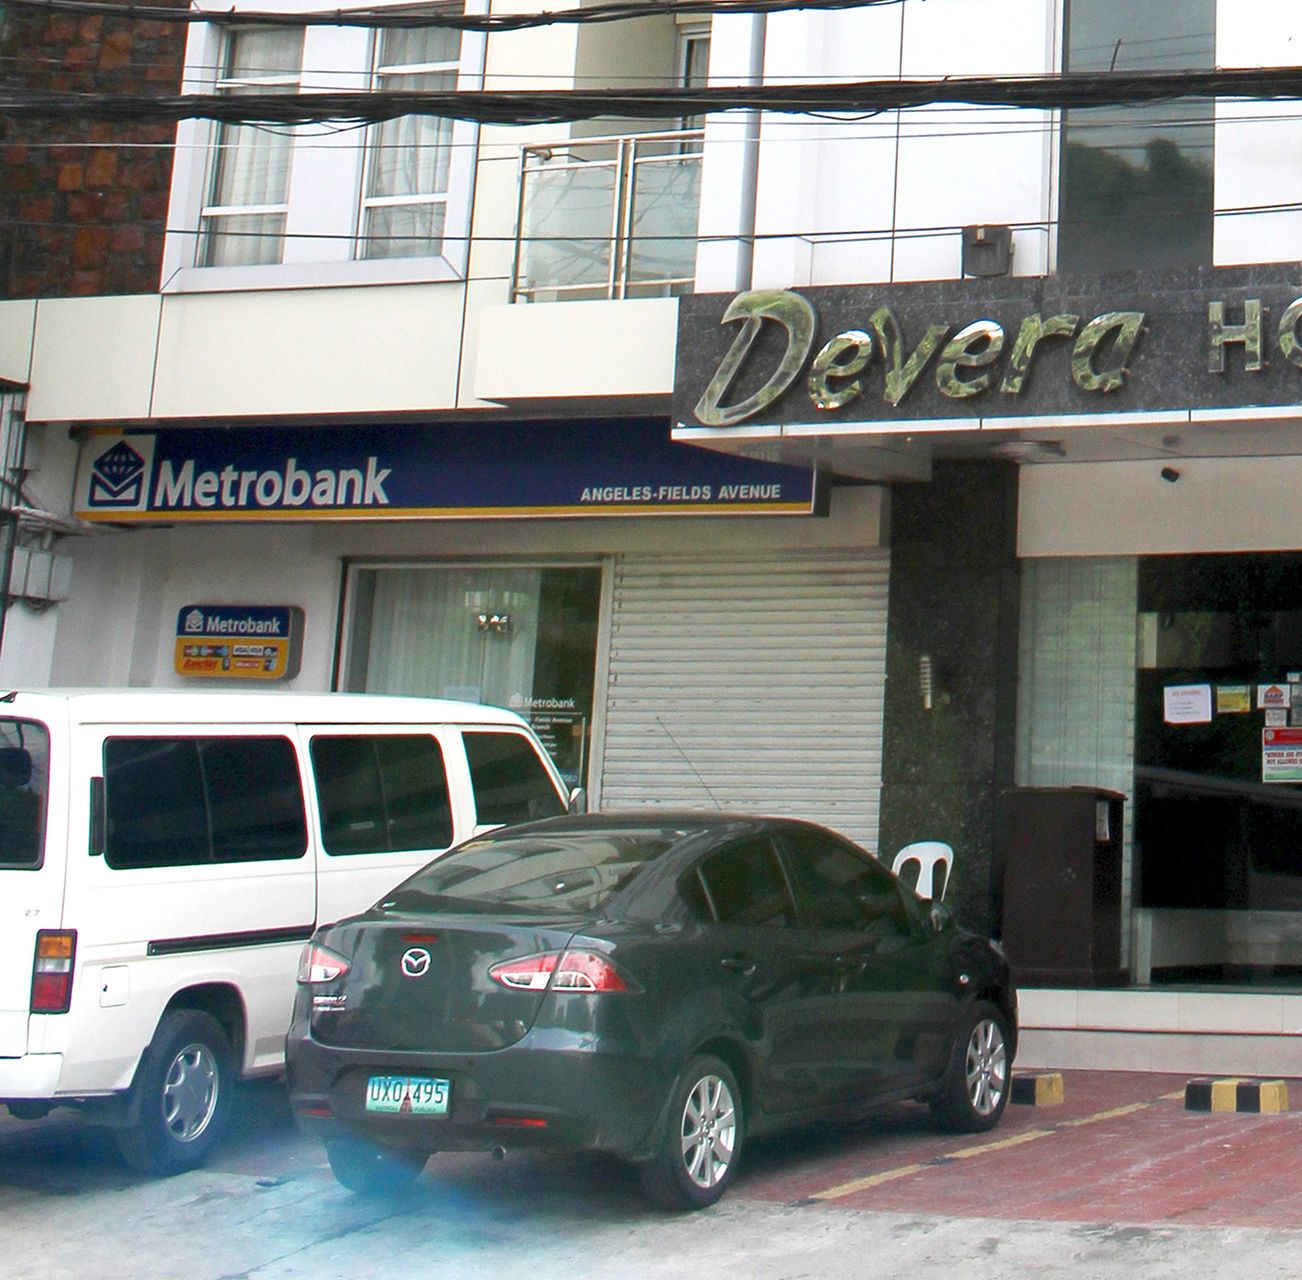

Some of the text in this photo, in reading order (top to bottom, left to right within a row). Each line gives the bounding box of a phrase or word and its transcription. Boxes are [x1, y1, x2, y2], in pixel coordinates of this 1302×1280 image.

[153, 455, 393, 508] Metrobank
[580, 483, 781, 502] ANGELES-FIELDS AVENUE
[206, 616, 280, 633] Metrobank
[524, 697, 576, 708] Metrobank
[413, 1082, 446, 1104] 495
